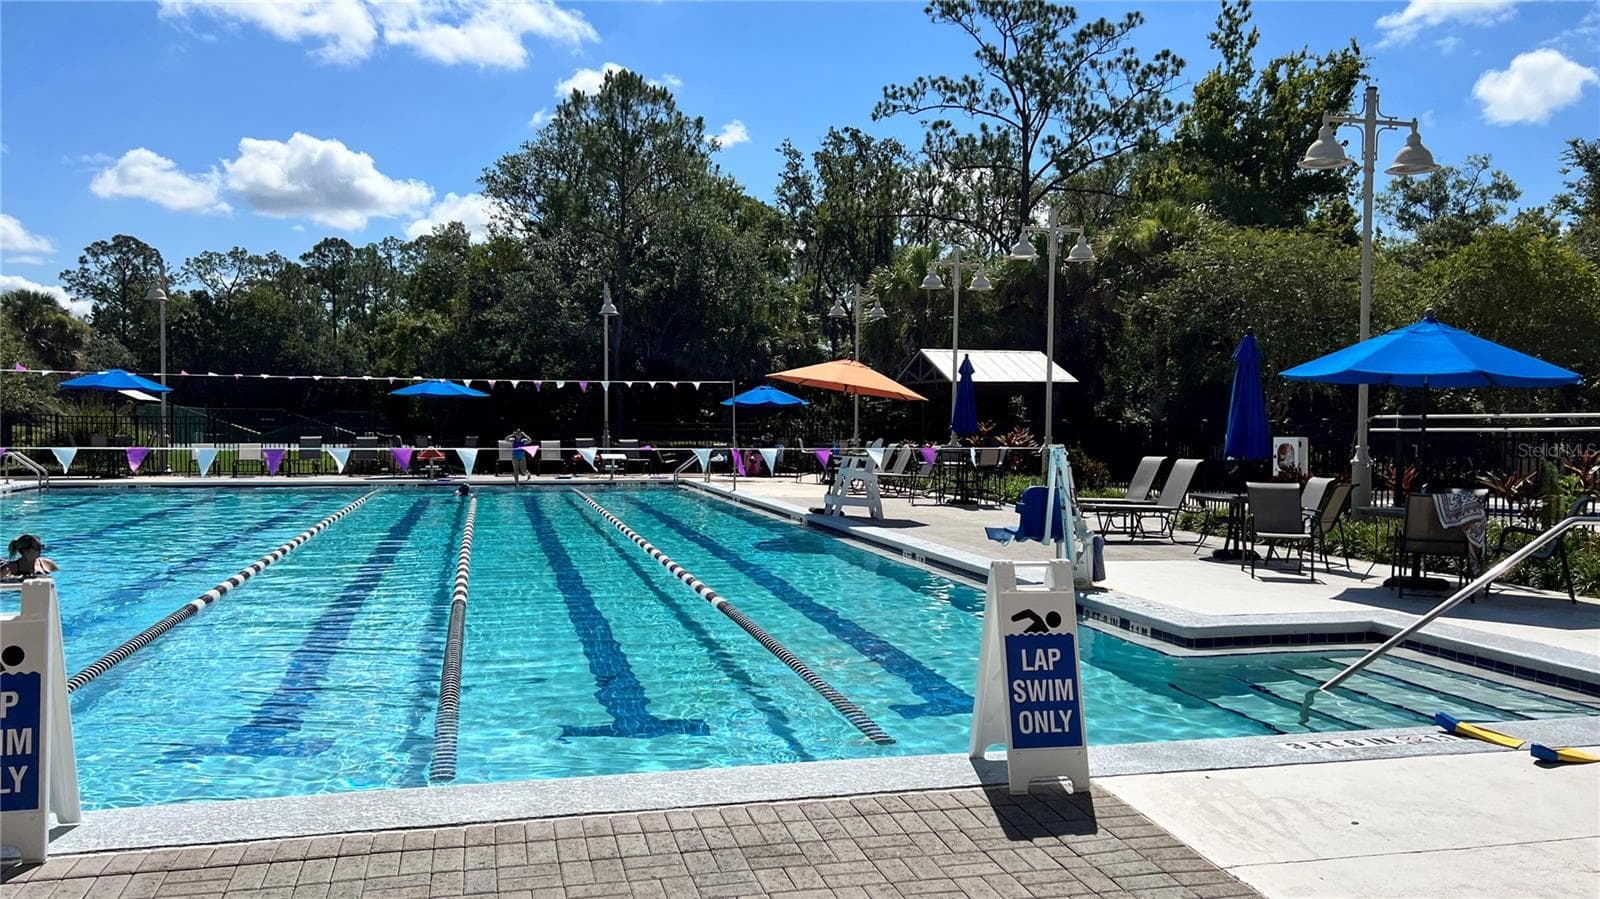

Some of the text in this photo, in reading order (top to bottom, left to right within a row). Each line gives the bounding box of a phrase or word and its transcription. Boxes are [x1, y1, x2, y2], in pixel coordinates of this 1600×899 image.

[1021, 648, 1061, 672] LAP
[1013, 678, 1074, 704] SWIM
[0, 691, 19, 719] P
[1018, 709, 1073, 735] ONLY
